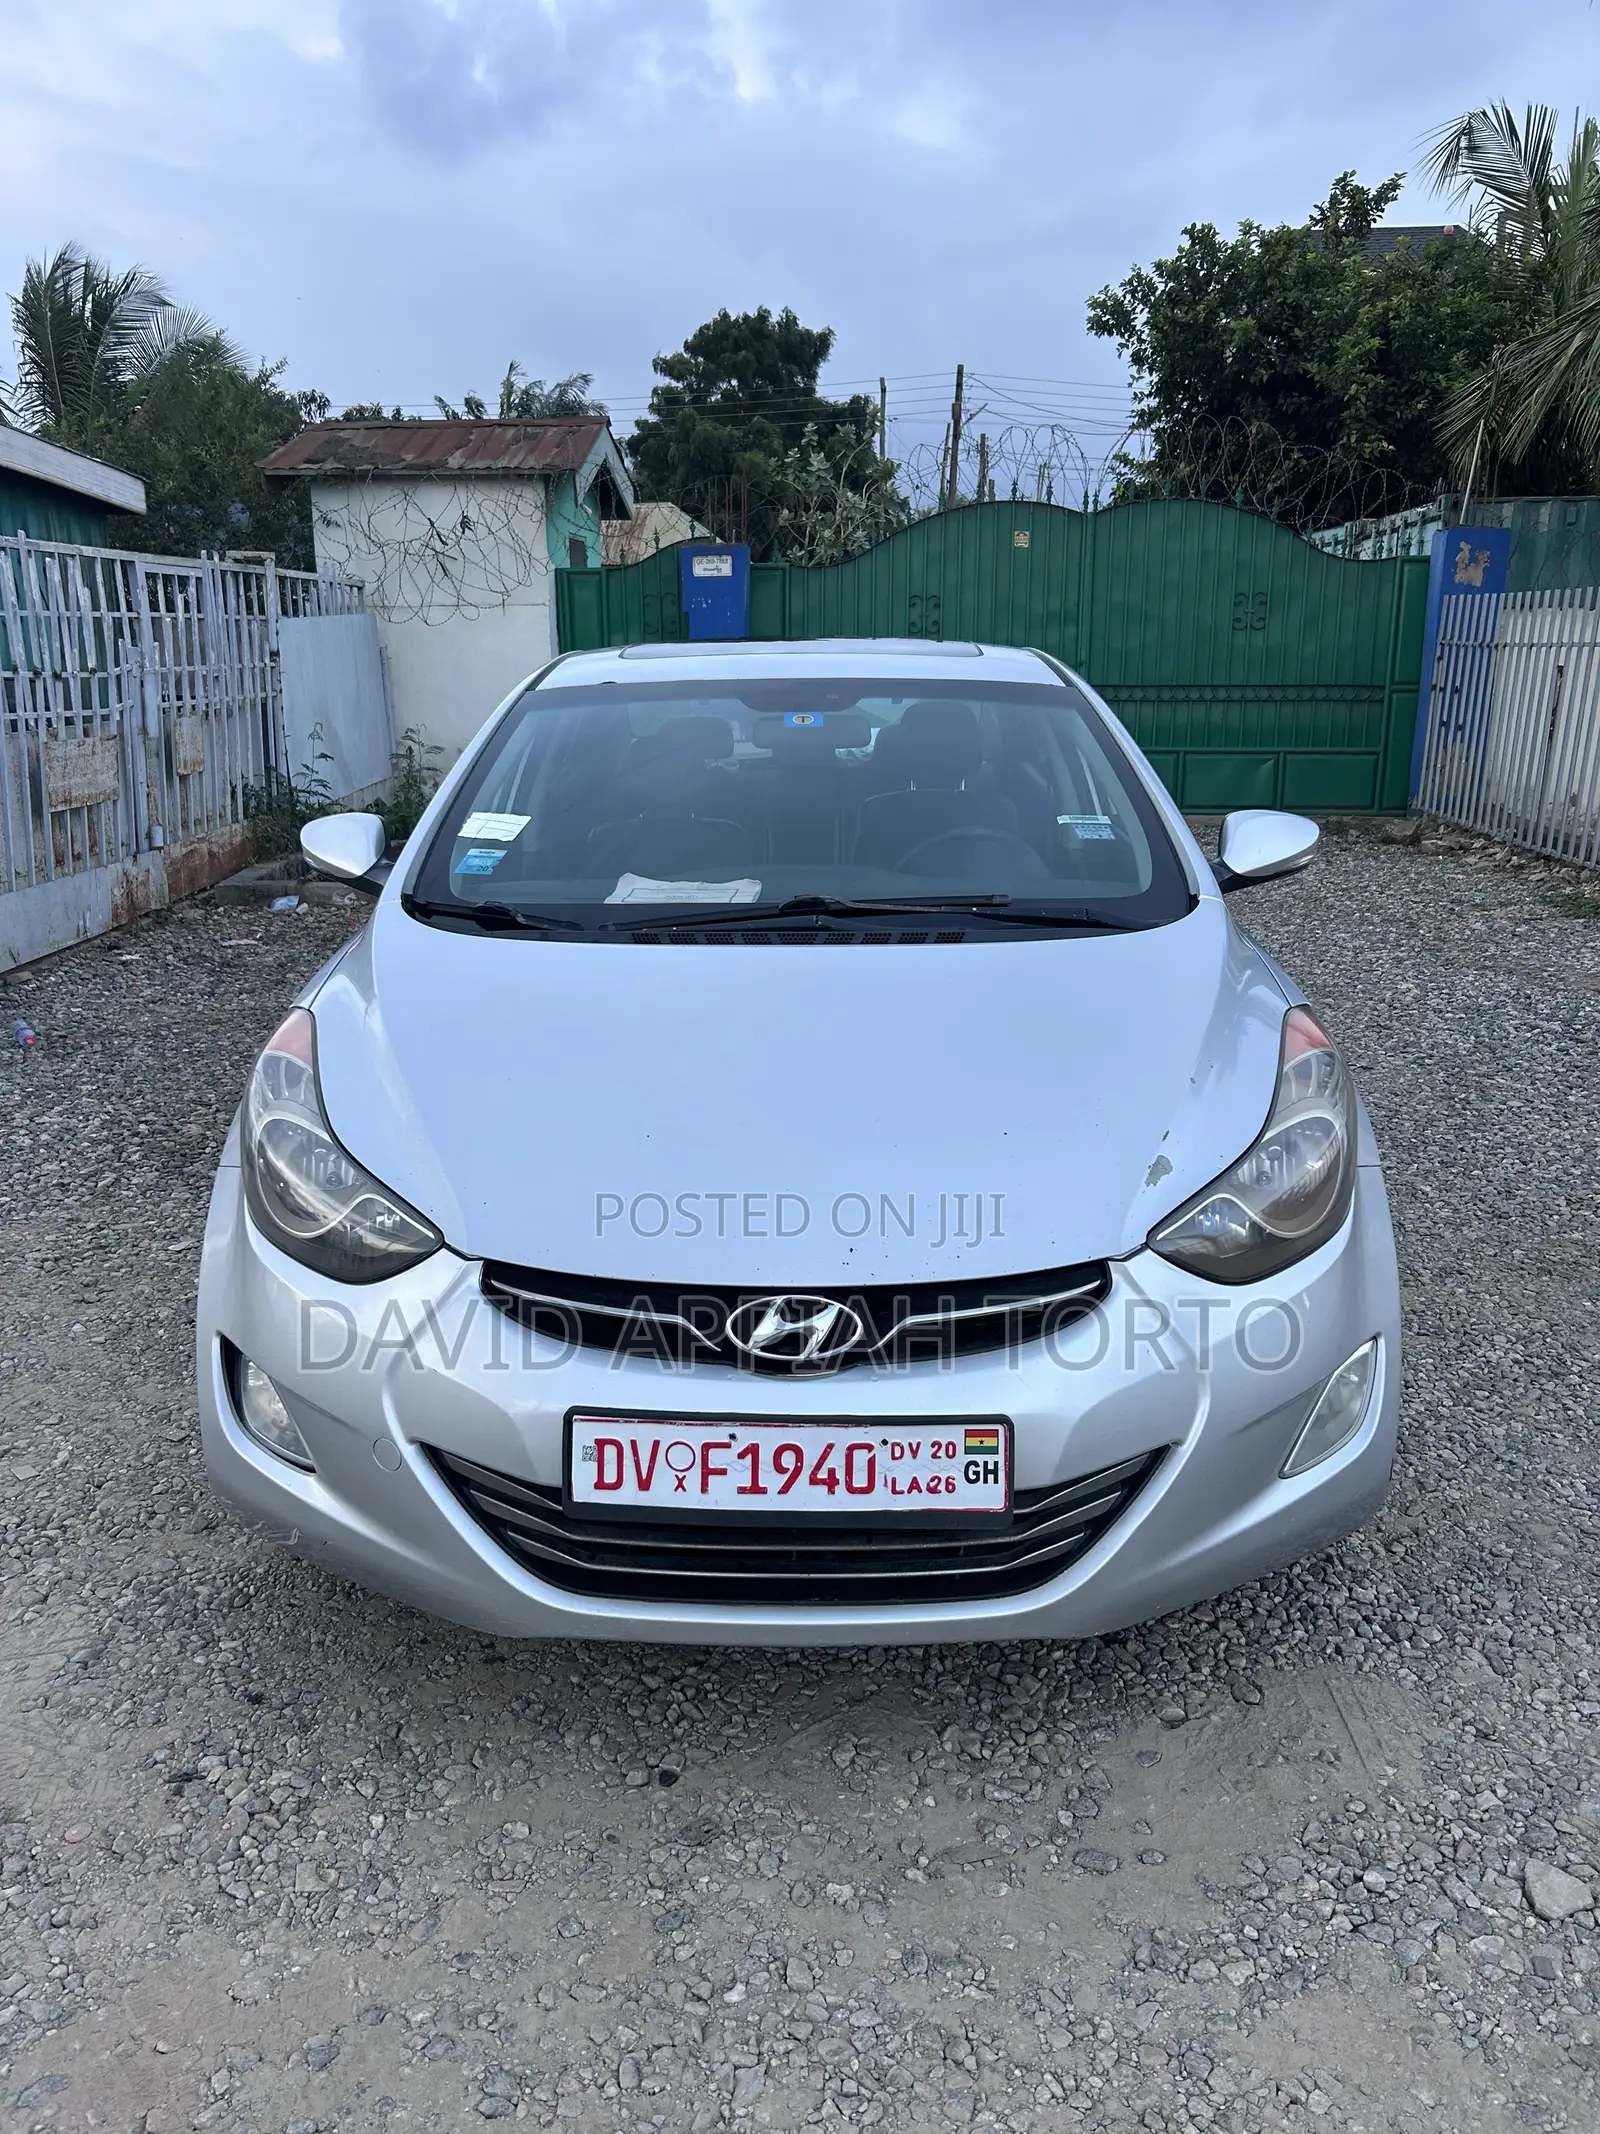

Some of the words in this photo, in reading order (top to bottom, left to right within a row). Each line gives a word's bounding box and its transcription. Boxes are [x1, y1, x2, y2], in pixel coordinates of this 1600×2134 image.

[890, 1440, 922, 1461] DV
[930, 1439, 957, 1460] 20
[963, 1459, 1000, 1485] GH
